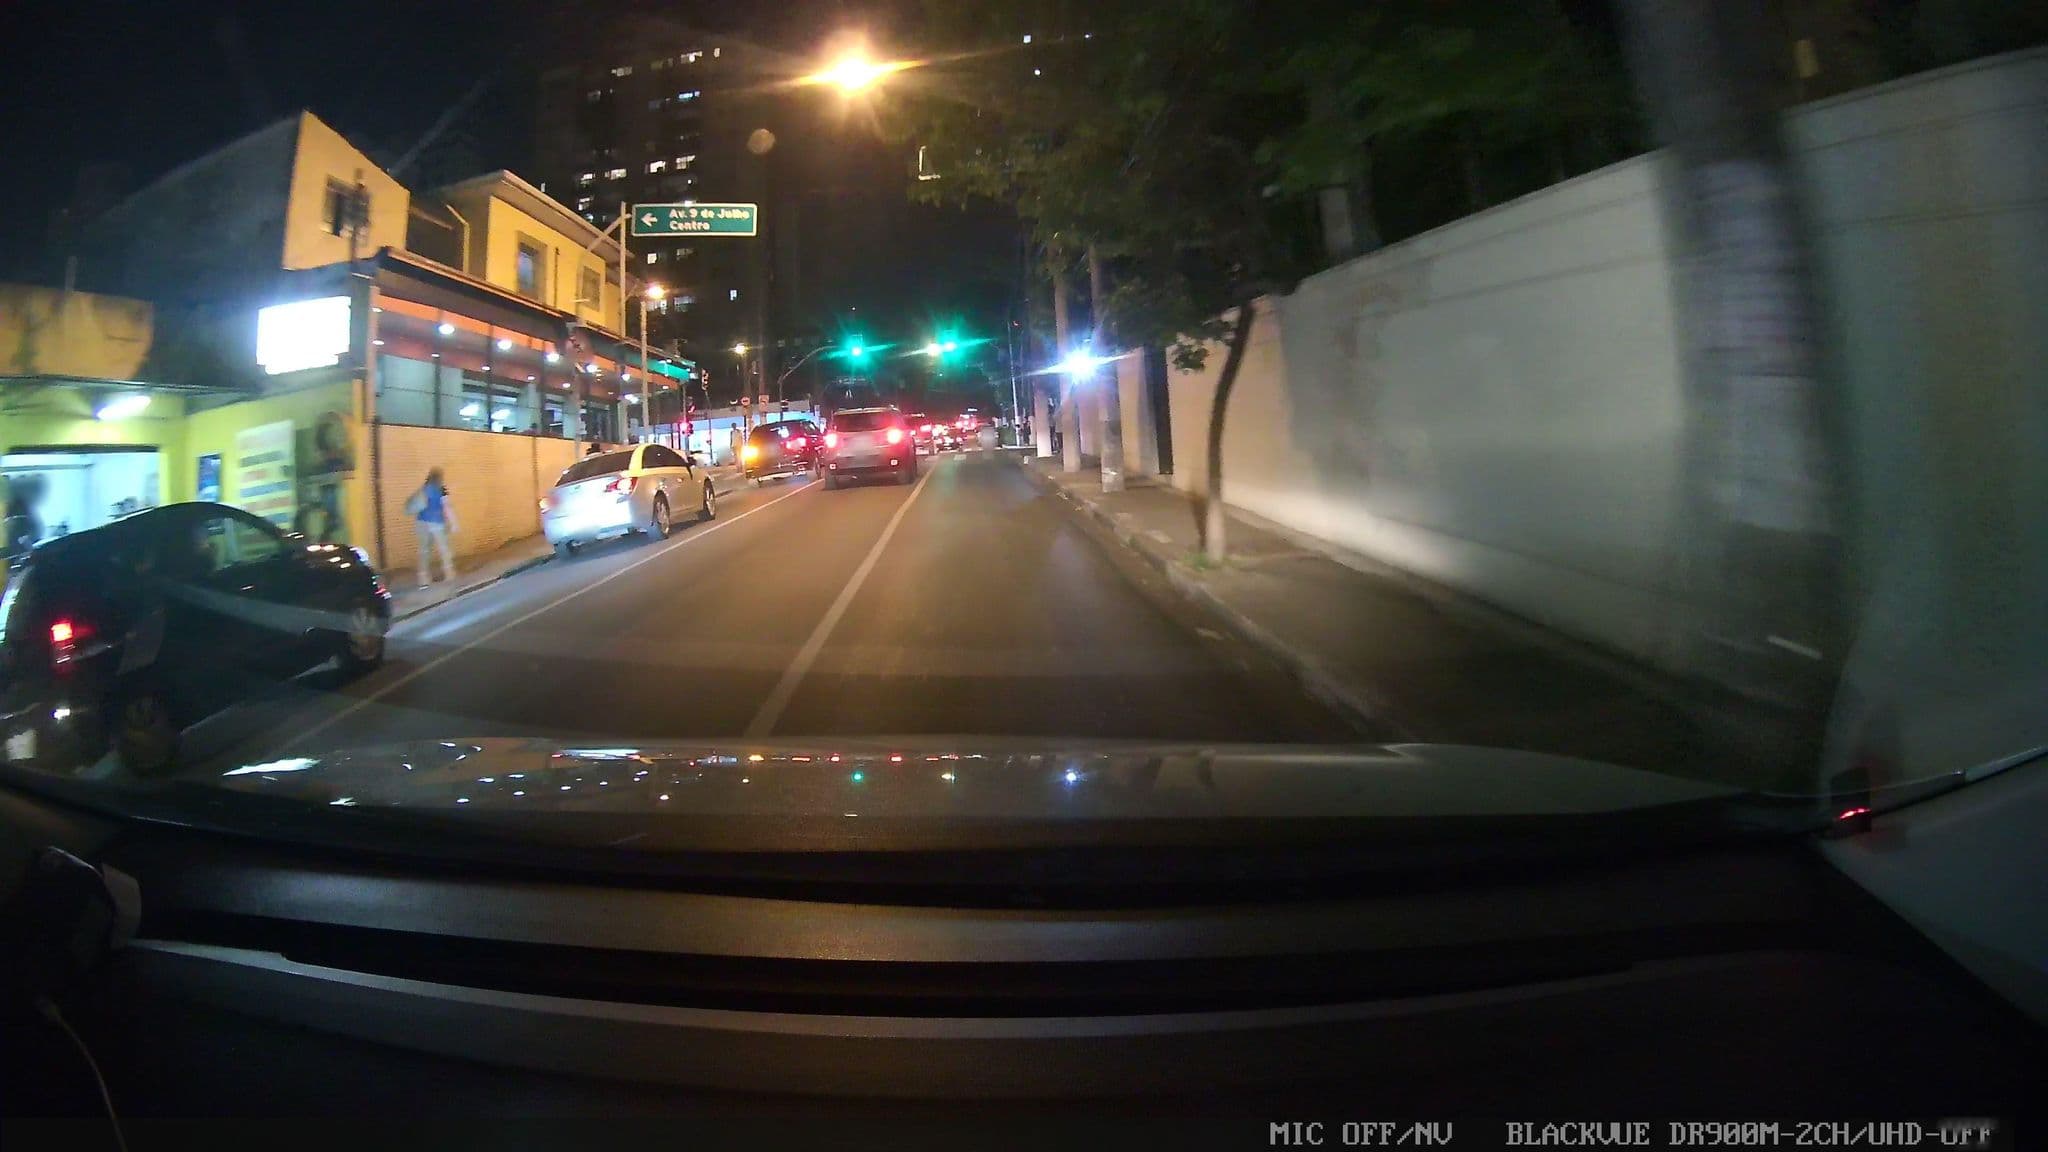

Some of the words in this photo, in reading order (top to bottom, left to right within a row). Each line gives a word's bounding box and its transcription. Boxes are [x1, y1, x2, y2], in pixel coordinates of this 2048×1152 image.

[669, 208, 687, 219] Av.
[689, 208, 698, 218] 9
[701, 208, 715, 219] de
[717, 208, 750, 219] Julho
[669, 220, 710, 231] Centro
